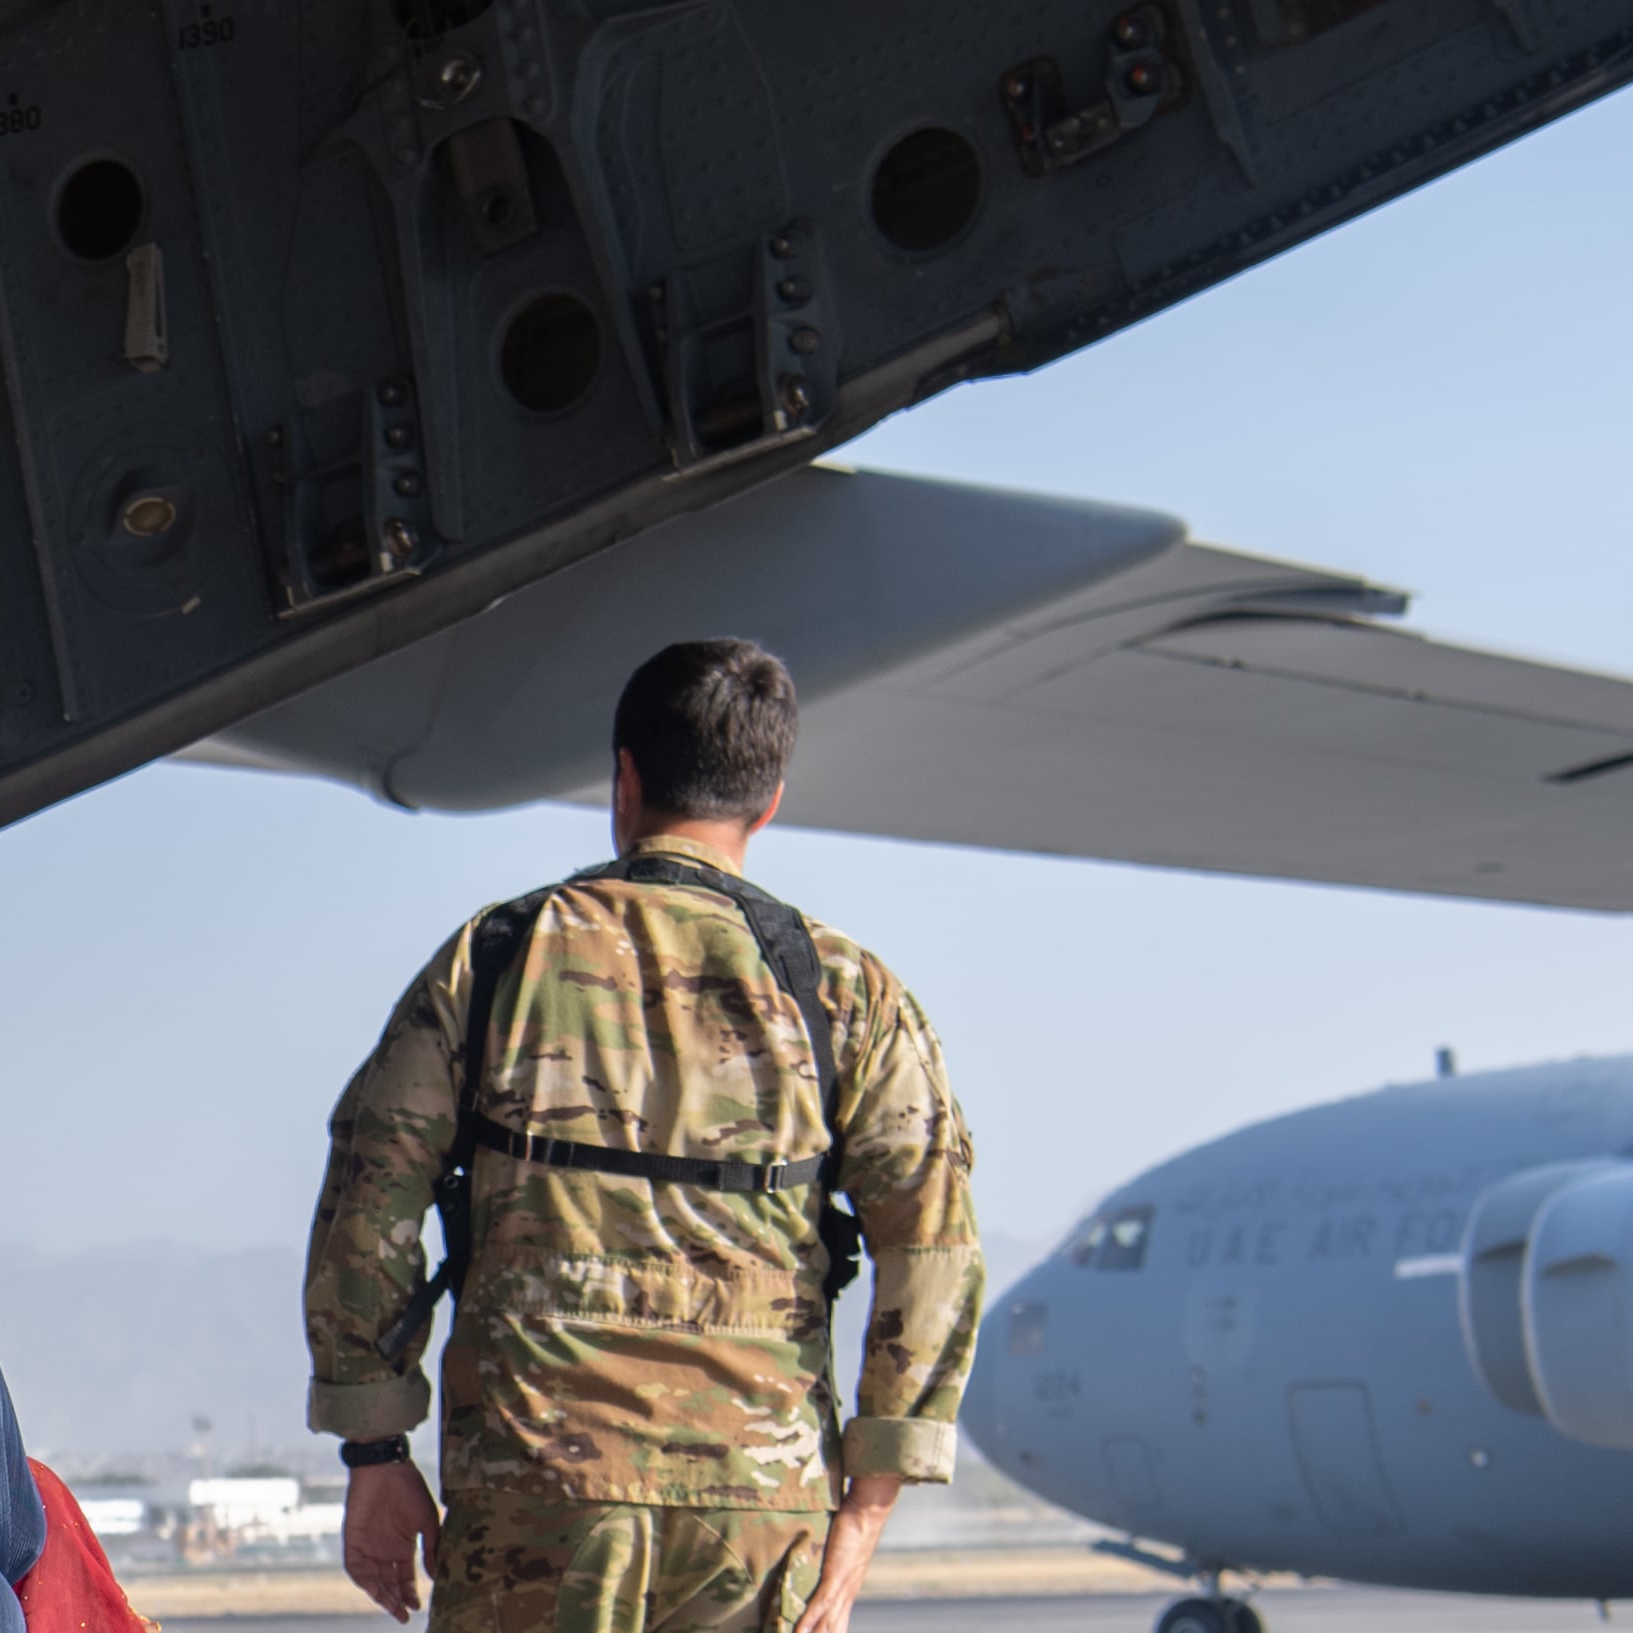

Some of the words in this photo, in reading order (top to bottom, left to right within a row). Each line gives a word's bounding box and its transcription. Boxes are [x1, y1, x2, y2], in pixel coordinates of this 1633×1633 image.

[178, 16, 235, 50] 1390
[1187, 1217, 1286, 1269] UAE
[1308, 1210, 1379, 1263] AIR
